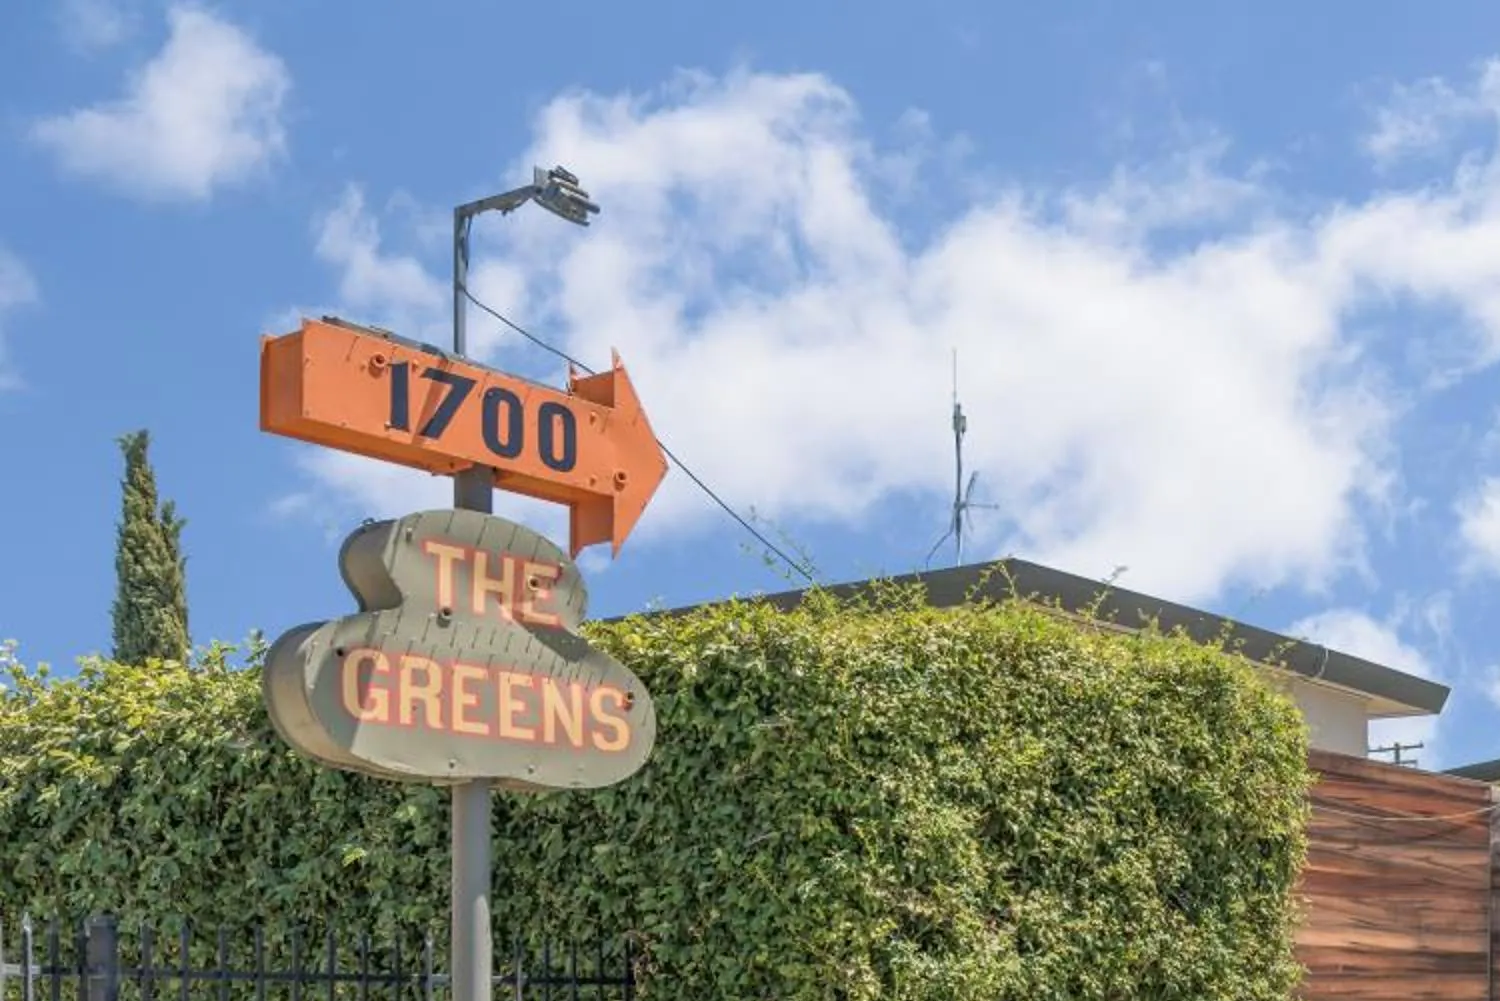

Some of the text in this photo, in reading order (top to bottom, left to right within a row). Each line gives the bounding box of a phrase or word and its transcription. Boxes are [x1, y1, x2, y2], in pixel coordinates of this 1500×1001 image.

[387, 361, 577, 472] 1700
[423, 540, 562, 627] THE
[341, 646, 634, 754] GREENS
